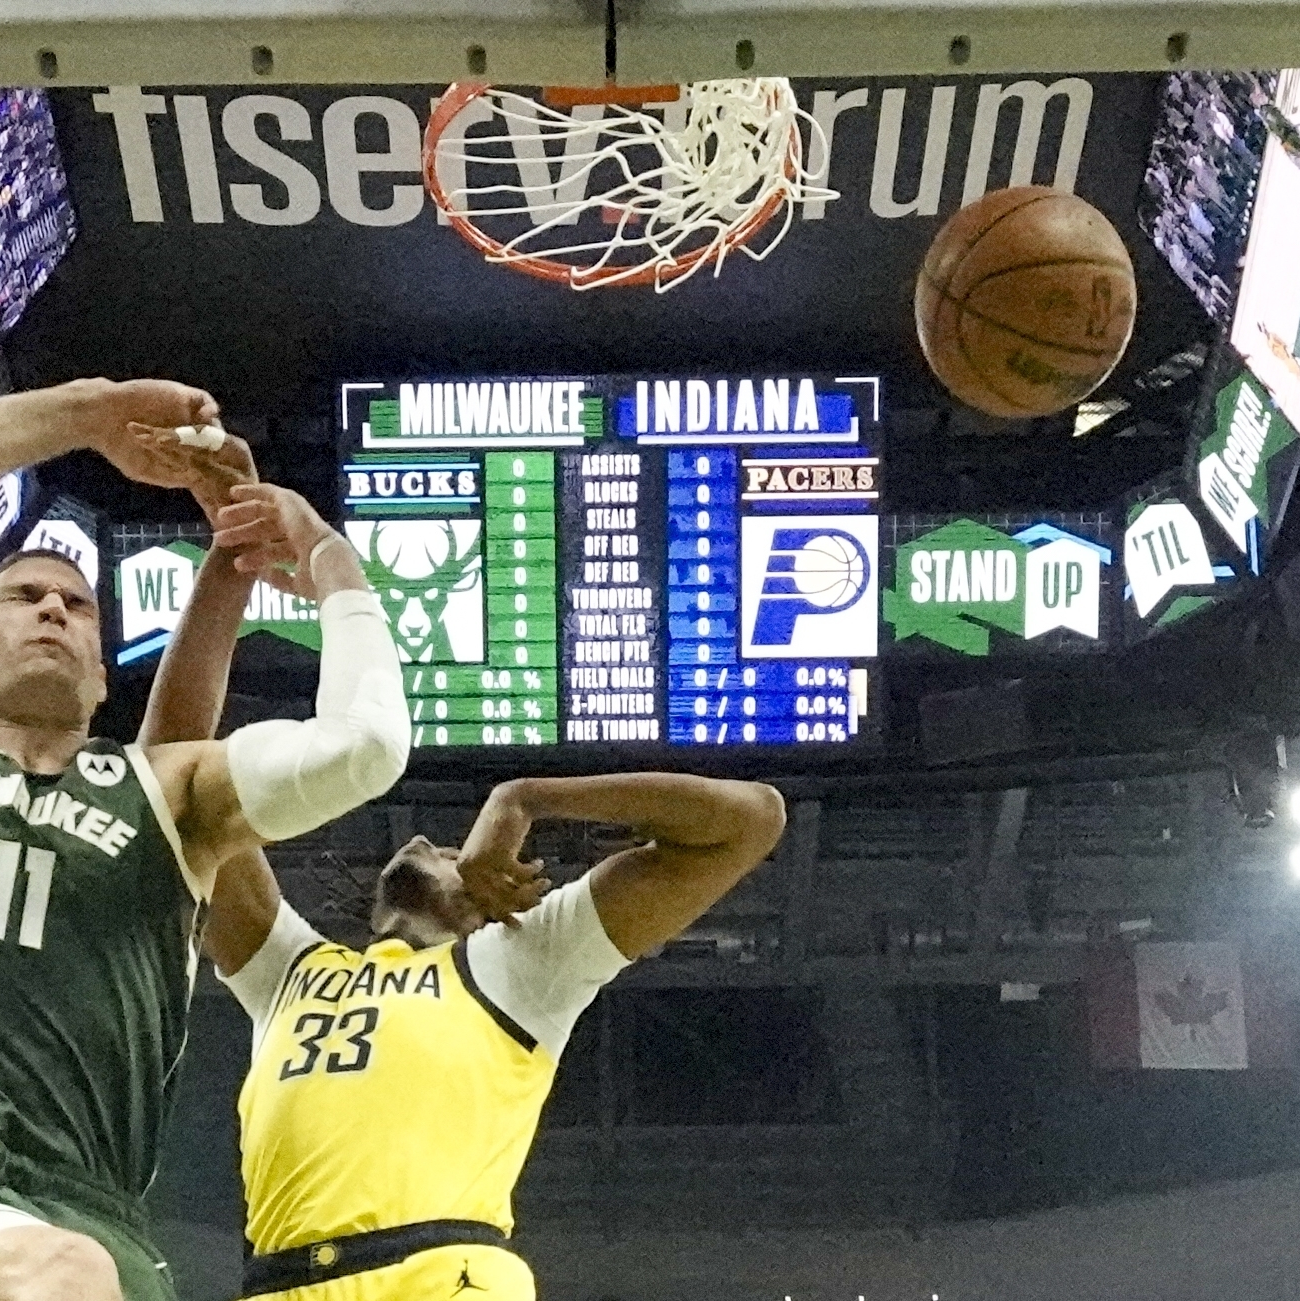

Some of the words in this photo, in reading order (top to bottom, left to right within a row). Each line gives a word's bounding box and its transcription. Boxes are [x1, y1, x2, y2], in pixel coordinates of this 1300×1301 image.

[400, 382, 585, 435] MILWAUKEE
[637, 379, 819, 432] INDIANA
[1223, 381, 1272, 489] SCORE!!
[512, 458, 525, 476] 0
[582, 454, 640, 475] ASSISTS
[697, 457, 710, 475] 0
[348, 471, 476, 496] BUCKS
[748, 467, 874, 490] PACERS
[513, 487, 525, 505] 0
[584, 481, 638, 503] BLOCKS
[697, 485, 710, 503] 0
[1208, 467, 1240, 522] WE
[513, 513, 526, 531] 0
[587, 508, 636, 529] STEALS
[697, 511, 710, 530] 0
[513, 540, 526, 558] 0
[584, 535, 609, 556] OFF
[697, 537, 710, 556] 0
[514, 567, 527, 585] 0
[697, 565, 710, 583] 0
[911, 549, 1017, 603] STAND
[1062, 561, 1083, 609] UP
[1133, 521, 1190, 577] 'TIL
[136, 568, 179, 612] WE
[515, 594, 527, 612] 0
[572, 588, 652, 609] TURNOVERS
[697, 591, 710, 610] 0
[515, 620, 527, 638] 0
[579, 615, 618, 635] TOTAL
[622, 614, 646, 635] FLS
[697, 617, 710, 636] 0
[516, 646, 528, 664] 0
[624, 641, 649, 662] PTS
[697, 644, 710, 662] 0
[571, 667, 608, 689] FIELD
[611, 667, 654, 688] GOALS
[571, 693, 654, 715] 3-POINTERS
[567, 720, 599, 741] FREE
[601, 719, 659, 741] THROWS
[279, 1006, 380, 1081] 33
